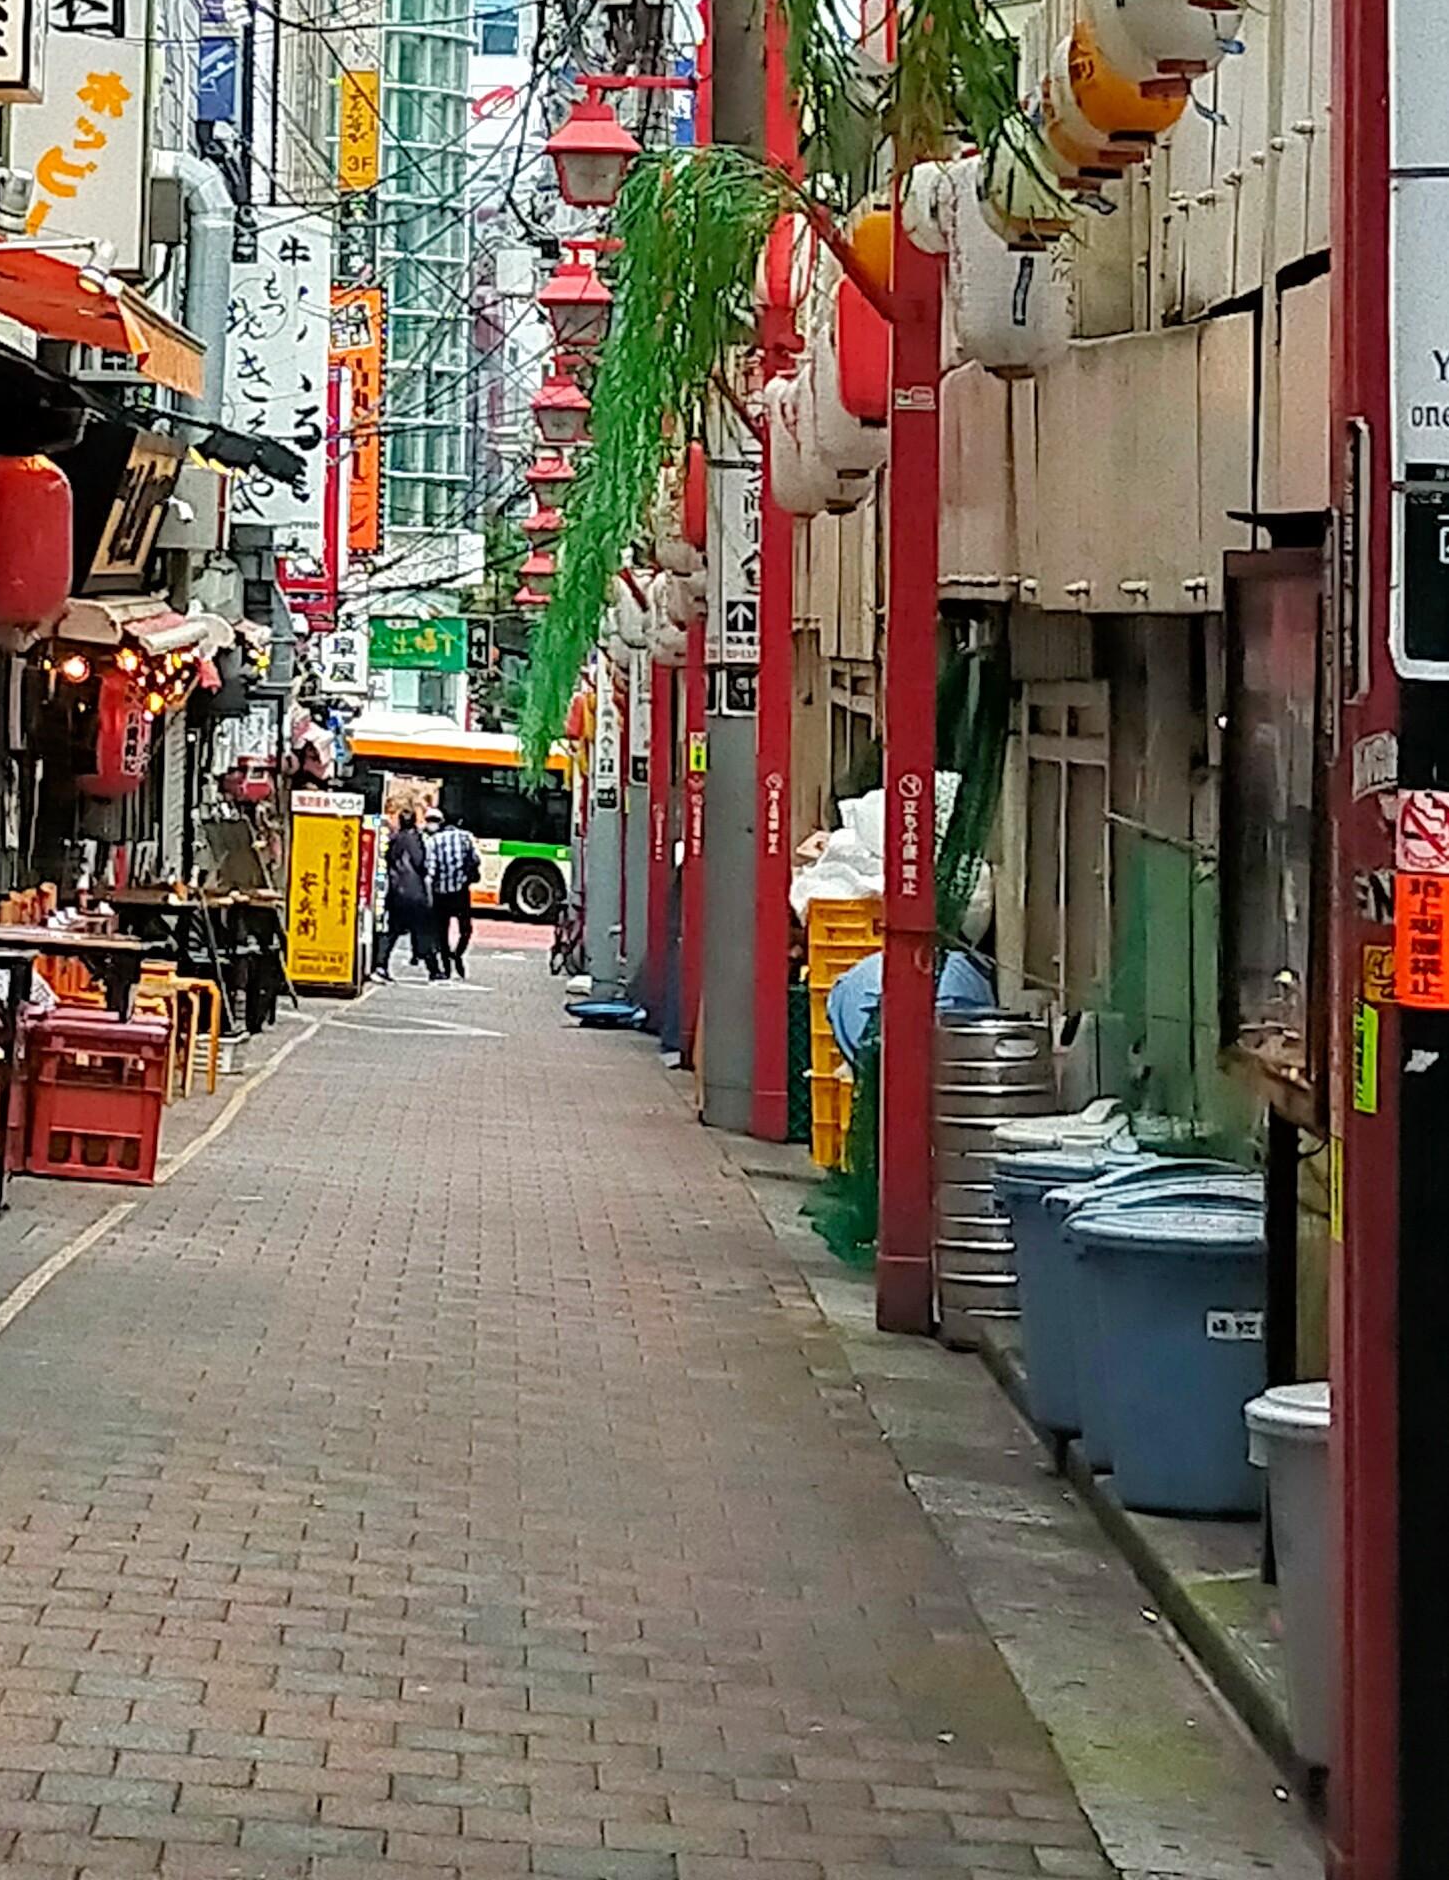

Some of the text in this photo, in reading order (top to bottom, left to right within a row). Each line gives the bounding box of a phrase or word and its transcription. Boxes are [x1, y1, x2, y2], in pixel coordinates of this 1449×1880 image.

[29, 70, 133, 238] ホッピー
[347, 156, 373, 172] 3F
